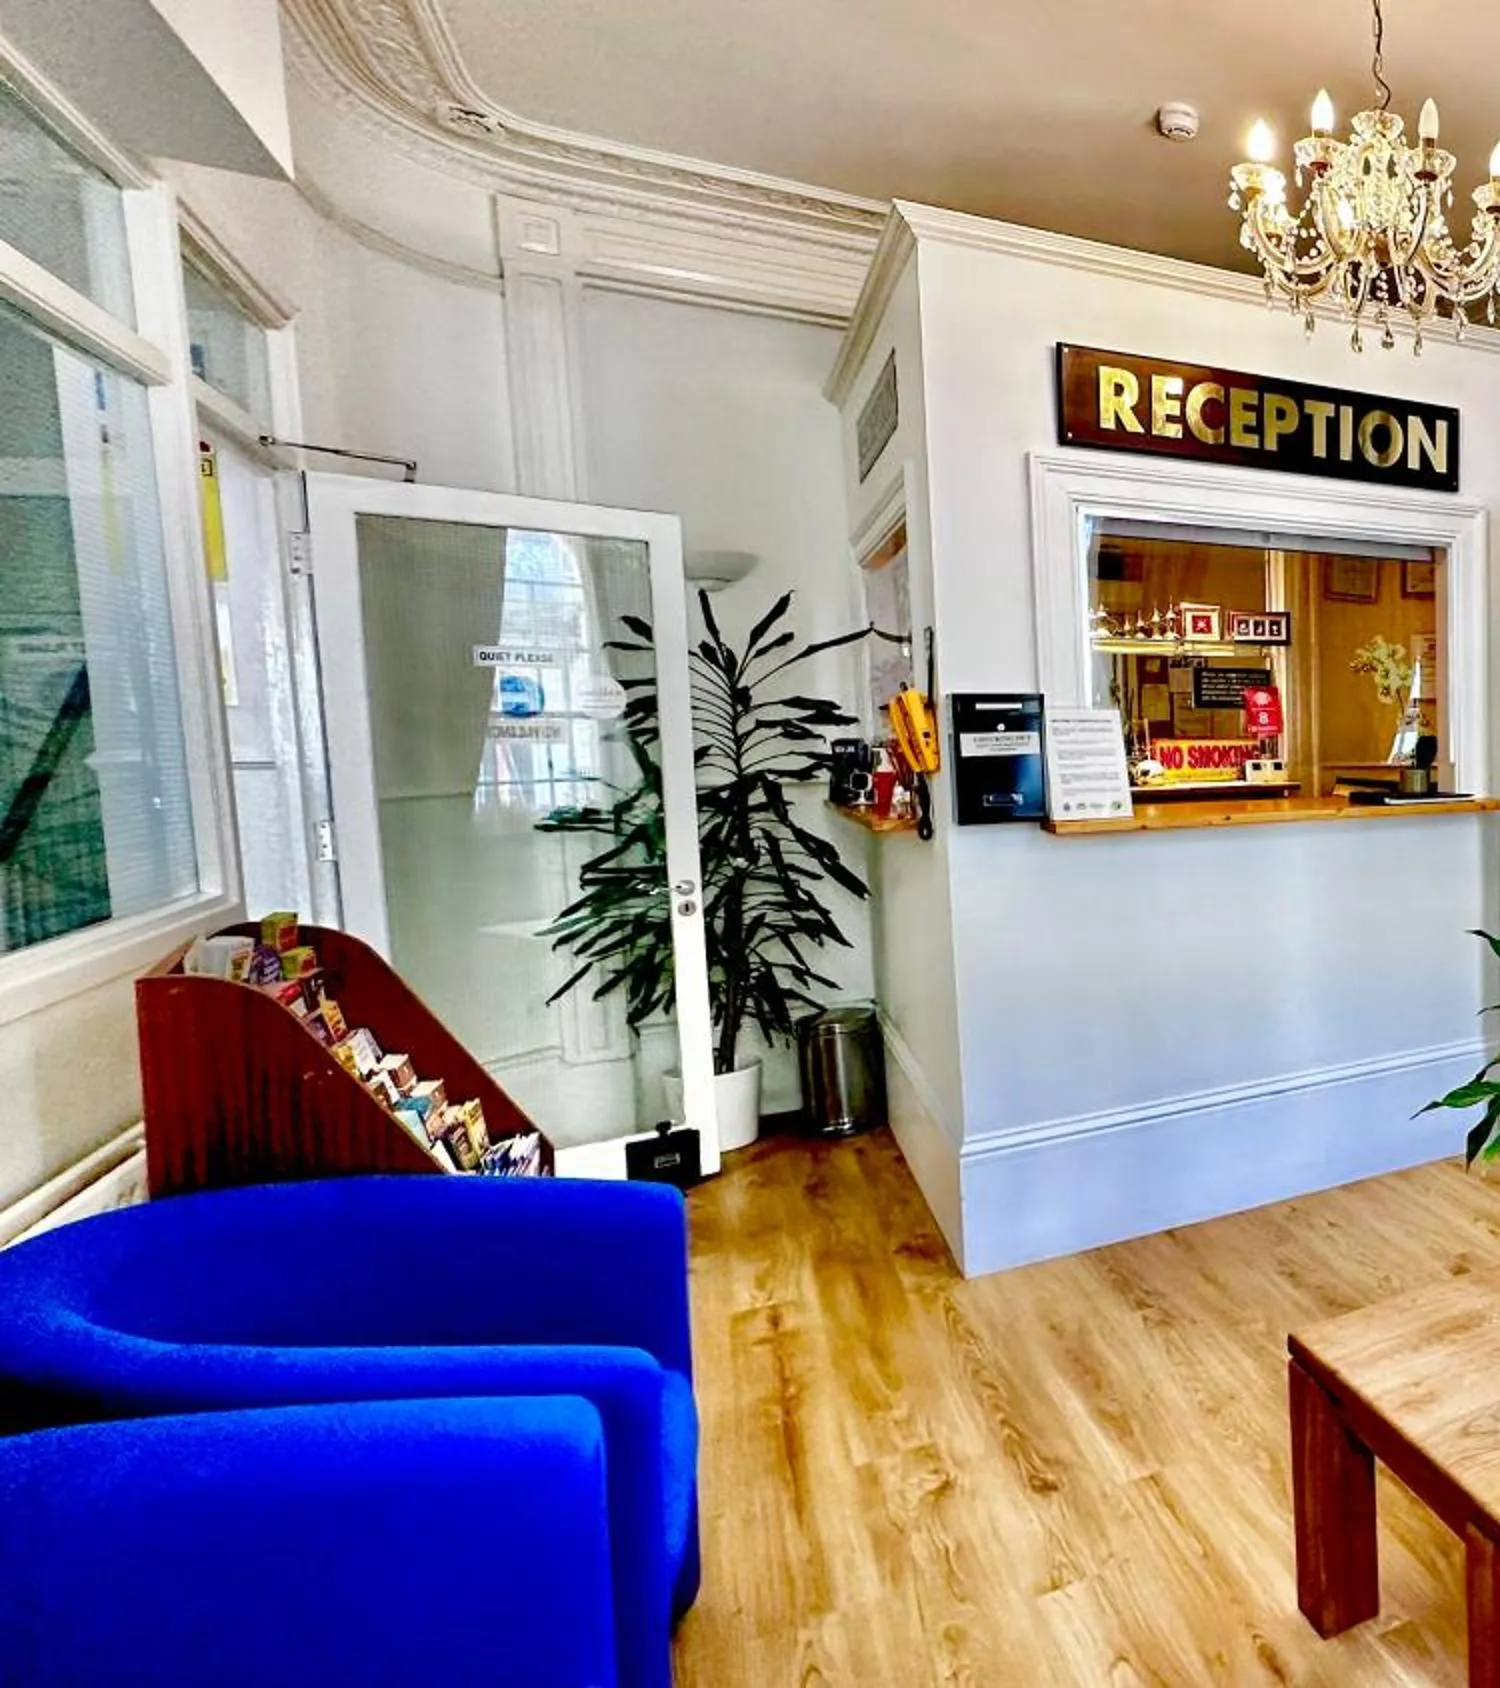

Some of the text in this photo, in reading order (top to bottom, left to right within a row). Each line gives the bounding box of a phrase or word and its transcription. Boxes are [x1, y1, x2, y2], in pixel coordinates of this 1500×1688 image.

[1098, 364, 1449, 474] RECEPTION
[479, 651, 511, 662] QUIET
[1160, 745, 1184, 769] NO
